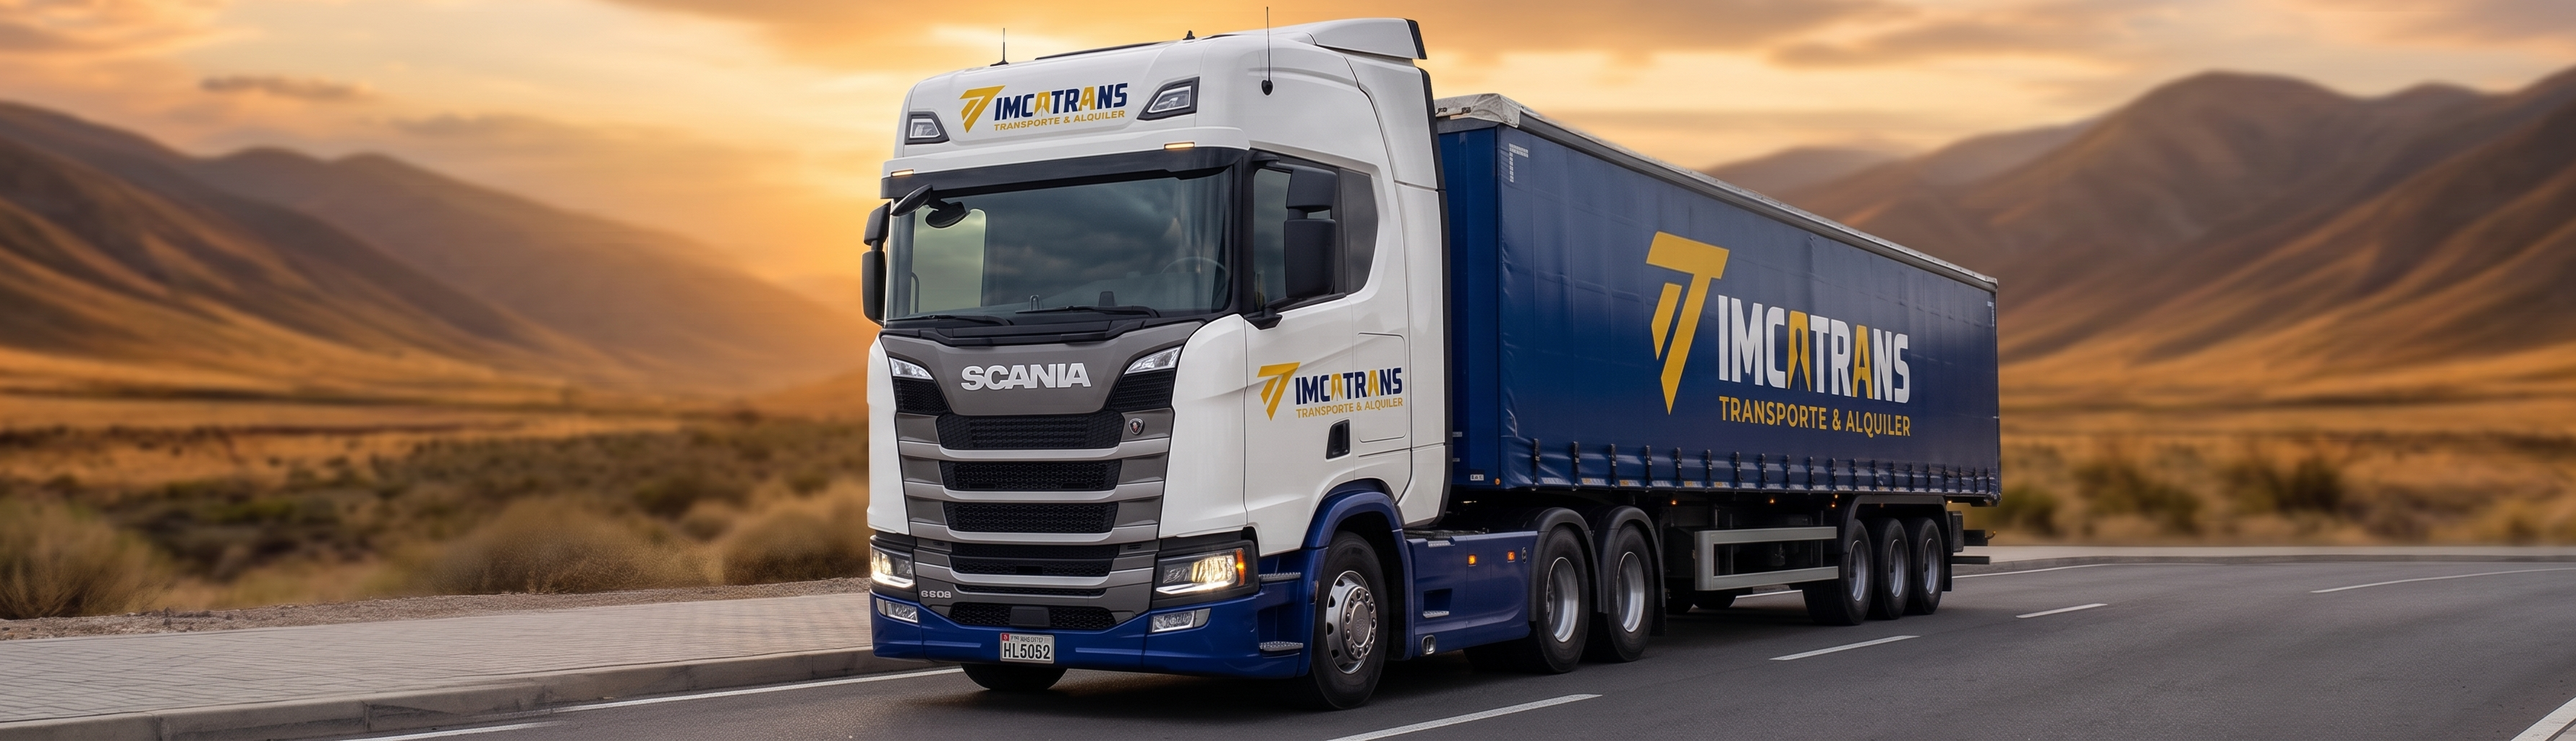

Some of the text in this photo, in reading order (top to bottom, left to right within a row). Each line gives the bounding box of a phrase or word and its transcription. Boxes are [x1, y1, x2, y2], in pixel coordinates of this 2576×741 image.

[994, 82, 1128, 121] IMCATRANS
[994, 117, 1060, 131] TRANSPORTE
[1074, 110, 1125, 122] ALQUILER
[1718, 295, 1910, 404] IMCATRANS
[961, 363, 1092, 391] SCANIA
[1296, 368, 1403, 405] IMCATRANS
[1296, 397, 1403, 418] TRANSPORTE & ALQUILER
[1719, 396, 1910, 438] TRANSPORTE & ALQUILER
